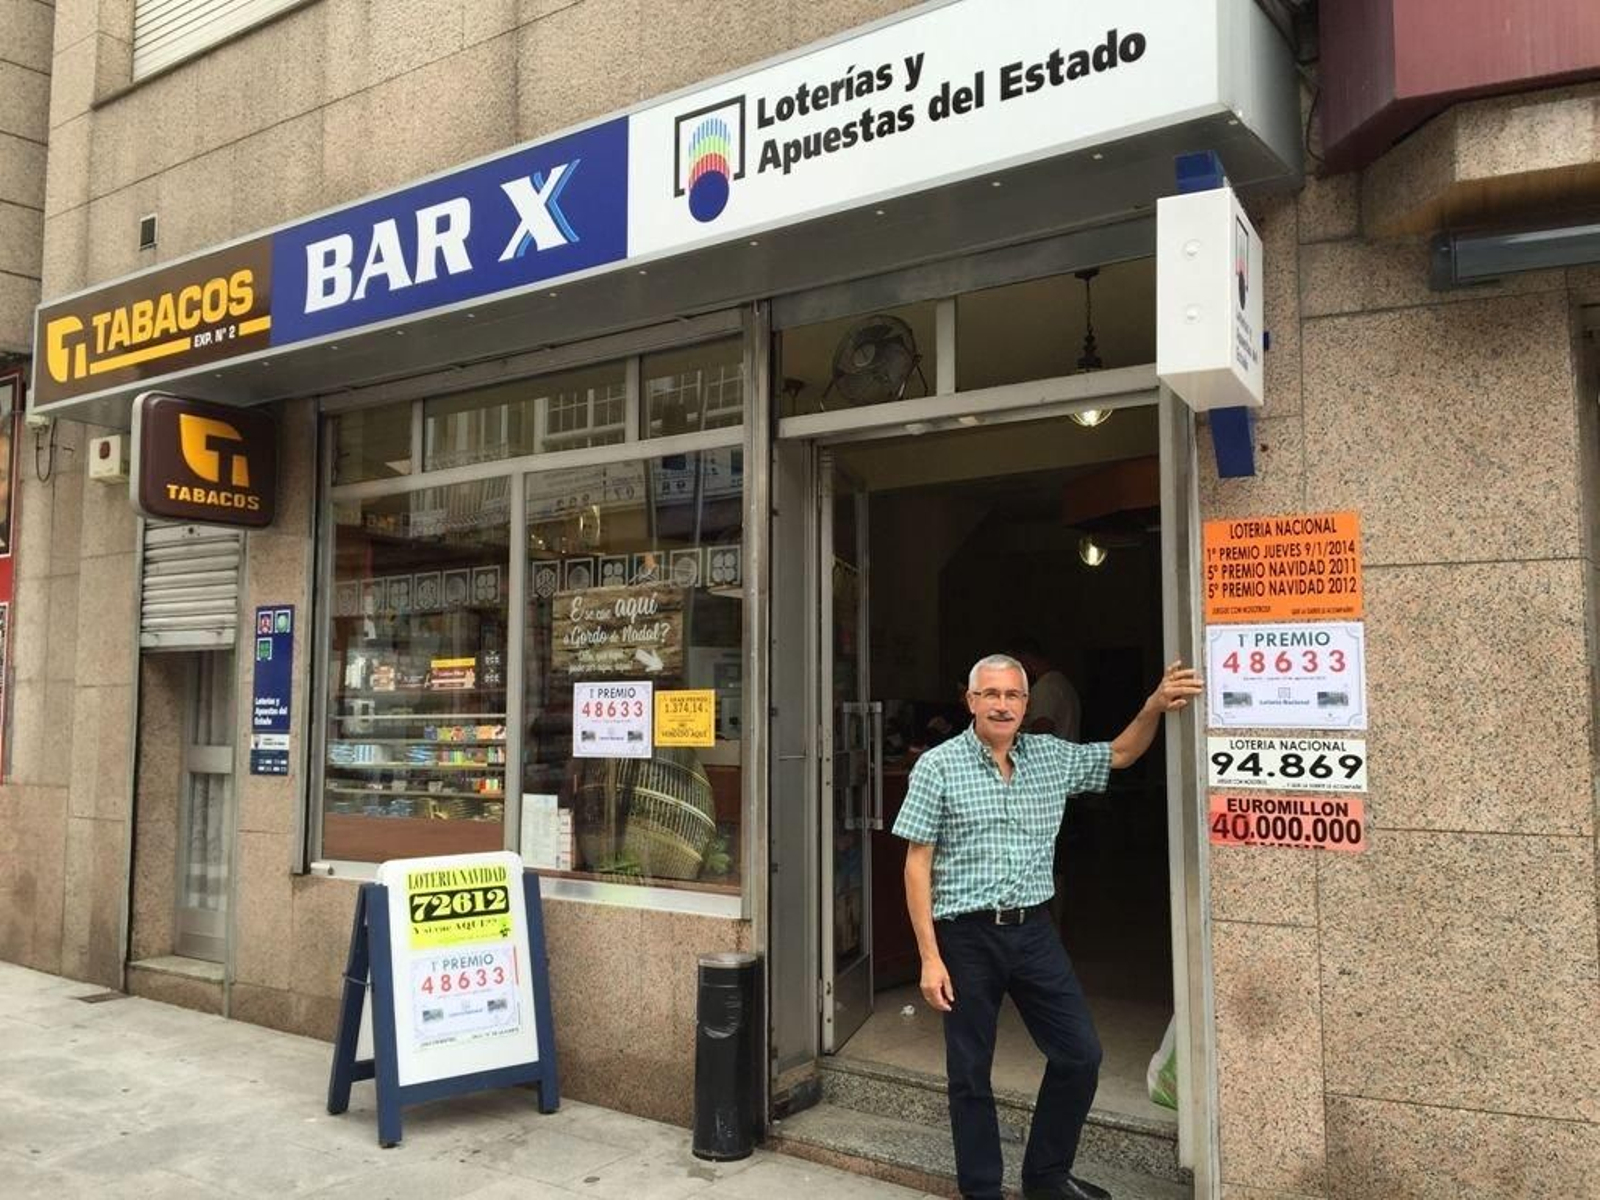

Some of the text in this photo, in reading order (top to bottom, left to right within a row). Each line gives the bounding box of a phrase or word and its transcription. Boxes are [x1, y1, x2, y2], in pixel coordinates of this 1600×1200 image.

[757, 51, 925, 130] Loterías y
[757, 28, 1146, 175] Apuestas del Estado
[304, 158, 582, 315] BAR X
[92, 269, 253, 354] TABACOS
[194, 332, 213, 348] EXP.
[228, 324, 236, 339] 2
[166, 484, 260, 511] TABACOS
[1230, 517, 1337, 540] LOTERIA NACIONAL
[1219, 545, 1260, 562] PREMIO
[1263, 543, 1301, 559] JUEVES
[1305, 540, 1355, 559] 9/1/2014
[1222, 562, 1265, 579] PREMIO
[1269, 560, 1326, 577] NAVIDAD
[1328, 558, 1357, 575] 2011
[1222, 581, 1265, 598] PREMIO
[1269, 579, 1325, 596] NAVIDAD
[1328, 576, 1357, 594] 2012
[614, 592, 658, 624] aquí
[570, 626, 608, 648] Gordo
[622, 622, 671, 644] Nadal?
[1255, 631, 1330, 648] PREMIO
[1222, 650, 1346, 674] 48633
[597, 687, 637, 699] PREMIO
[582, 700, 644, 718] 48633
[1230, 738, 1347, 752] LOTERIA NACIONAL
[1211, 752, 1363, 779] 94.869
[1227, 798, 1349, 817] EUROMILLON
[1211, 813, 1362, 845] 40.000.000
[408, 866, 507, 890] LOTERIA NAVIDAD
[411, 889, 507, 921] 72612
[443, 953, 494, 970] PREMIO
[421, 967, 506, 995] 48633
